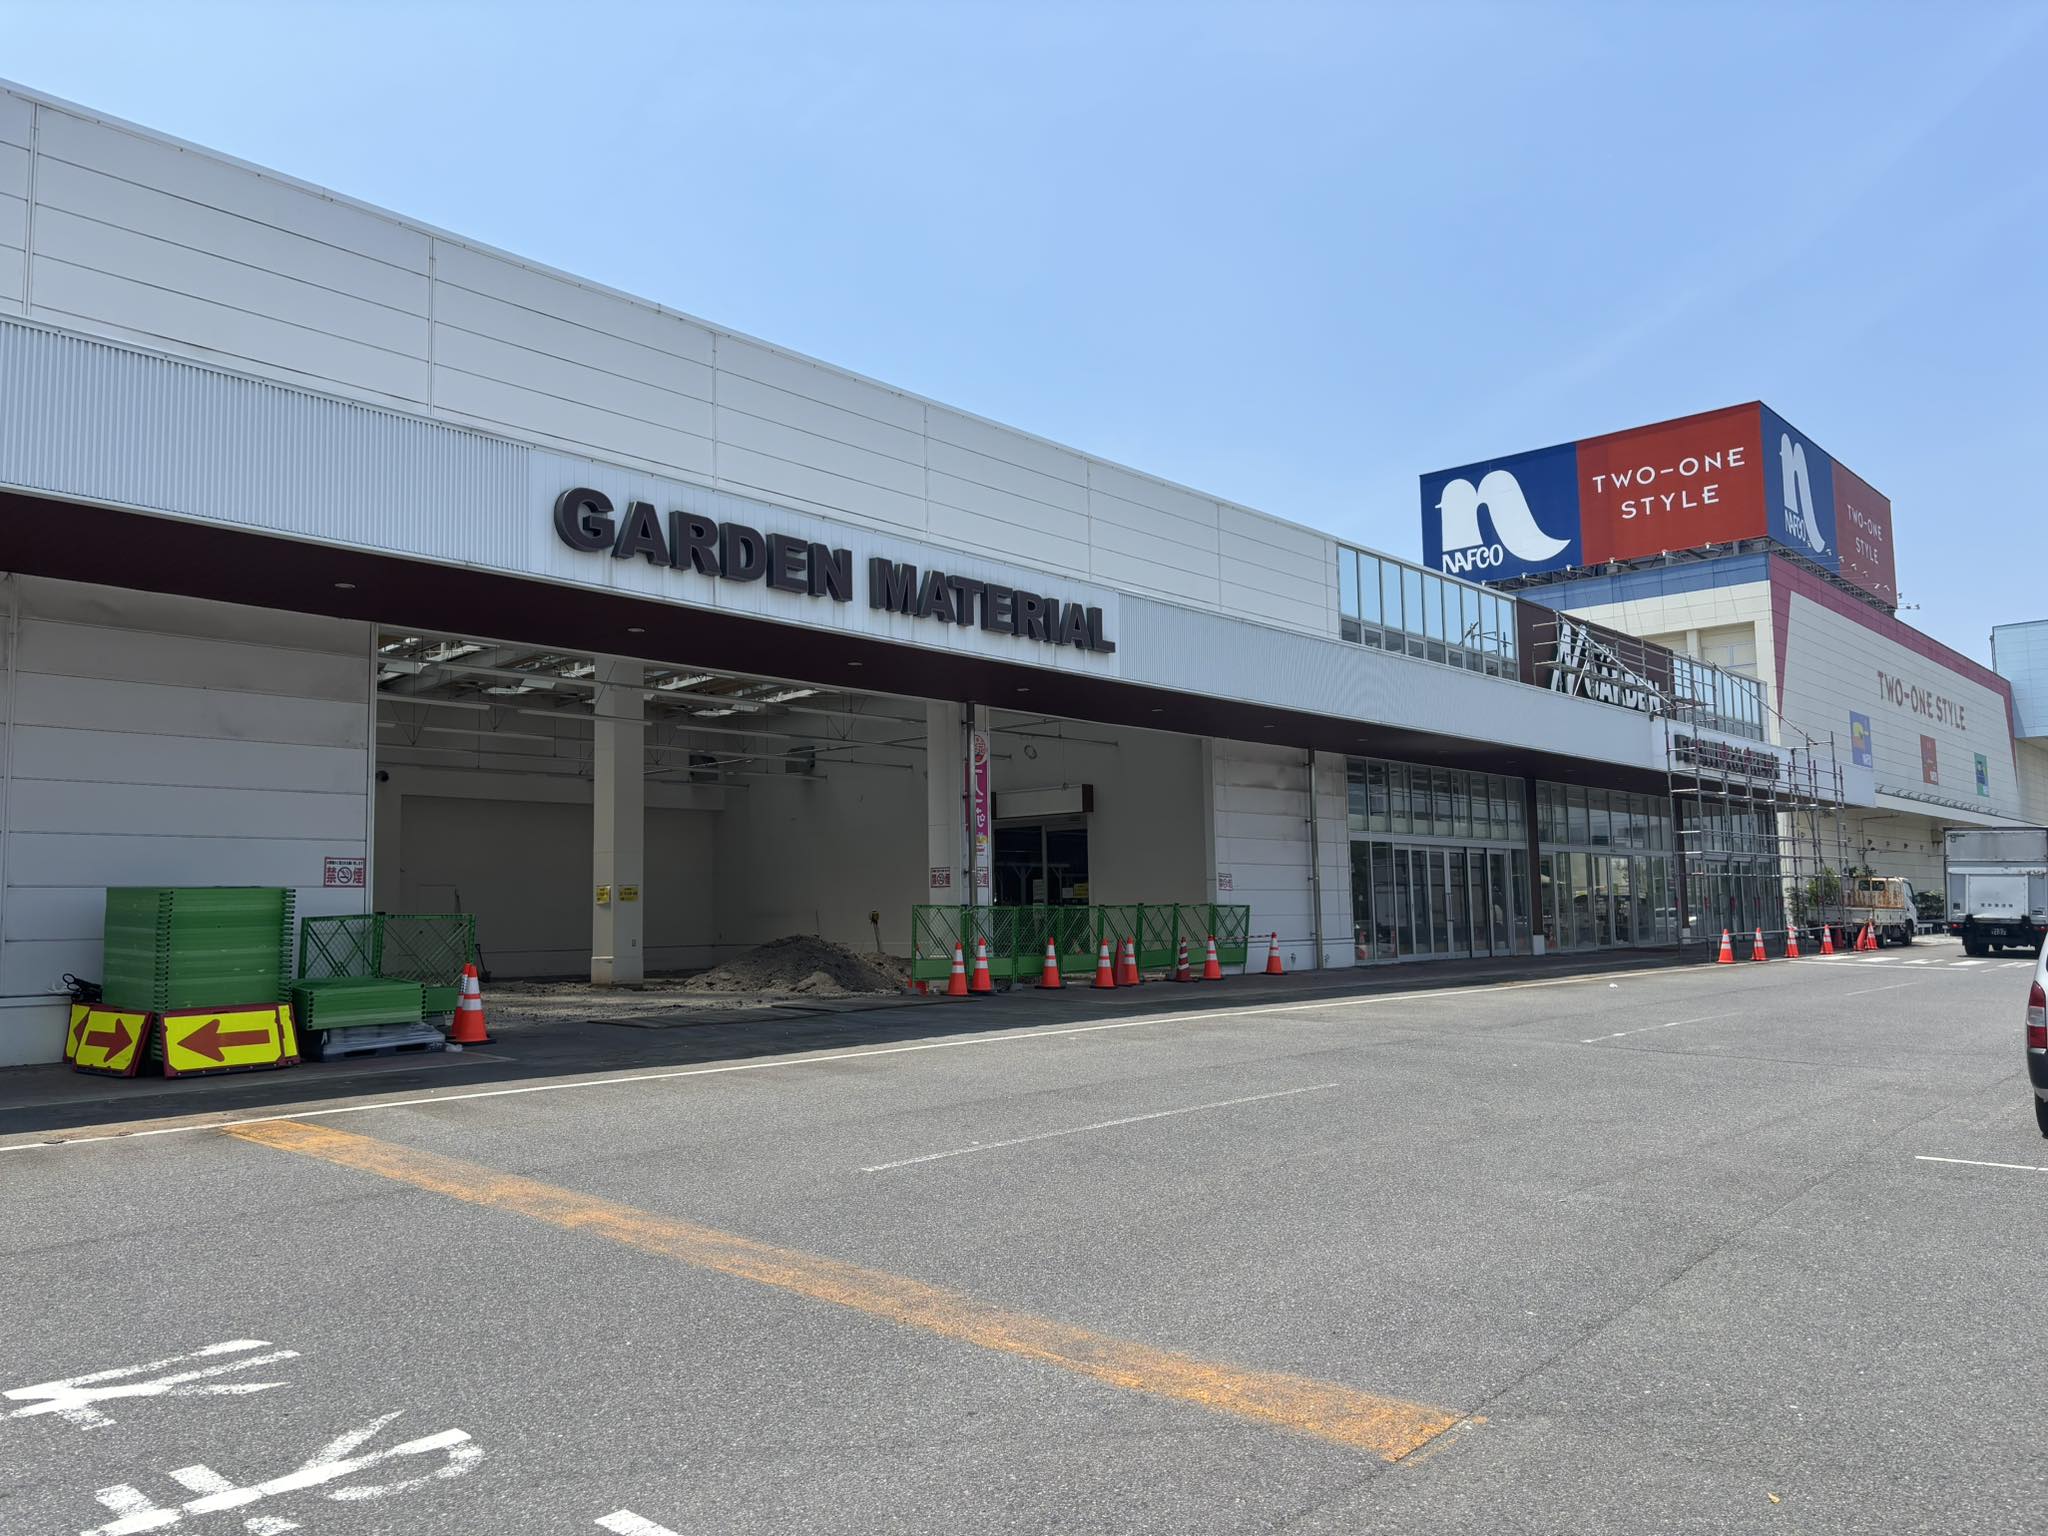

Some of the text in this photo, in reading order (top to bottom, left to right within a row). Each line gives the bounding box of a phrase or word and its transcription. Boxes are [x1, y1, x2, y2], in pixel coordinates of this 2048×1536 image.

[1592, 447, 1745, 494] TWO-ONE
[1621, 484, 1719, 519] STYLE
[1847, 504, 1882, 541] TWO-ONE
[1443, 544, 1504, 574] NAFCO
[1855, 537, 1879, 564] STYLE
[554, 487, 1115, 653] GARDEN MATERIAL
[1877, 670, 1966, 730] TWO-ONE STYLE
